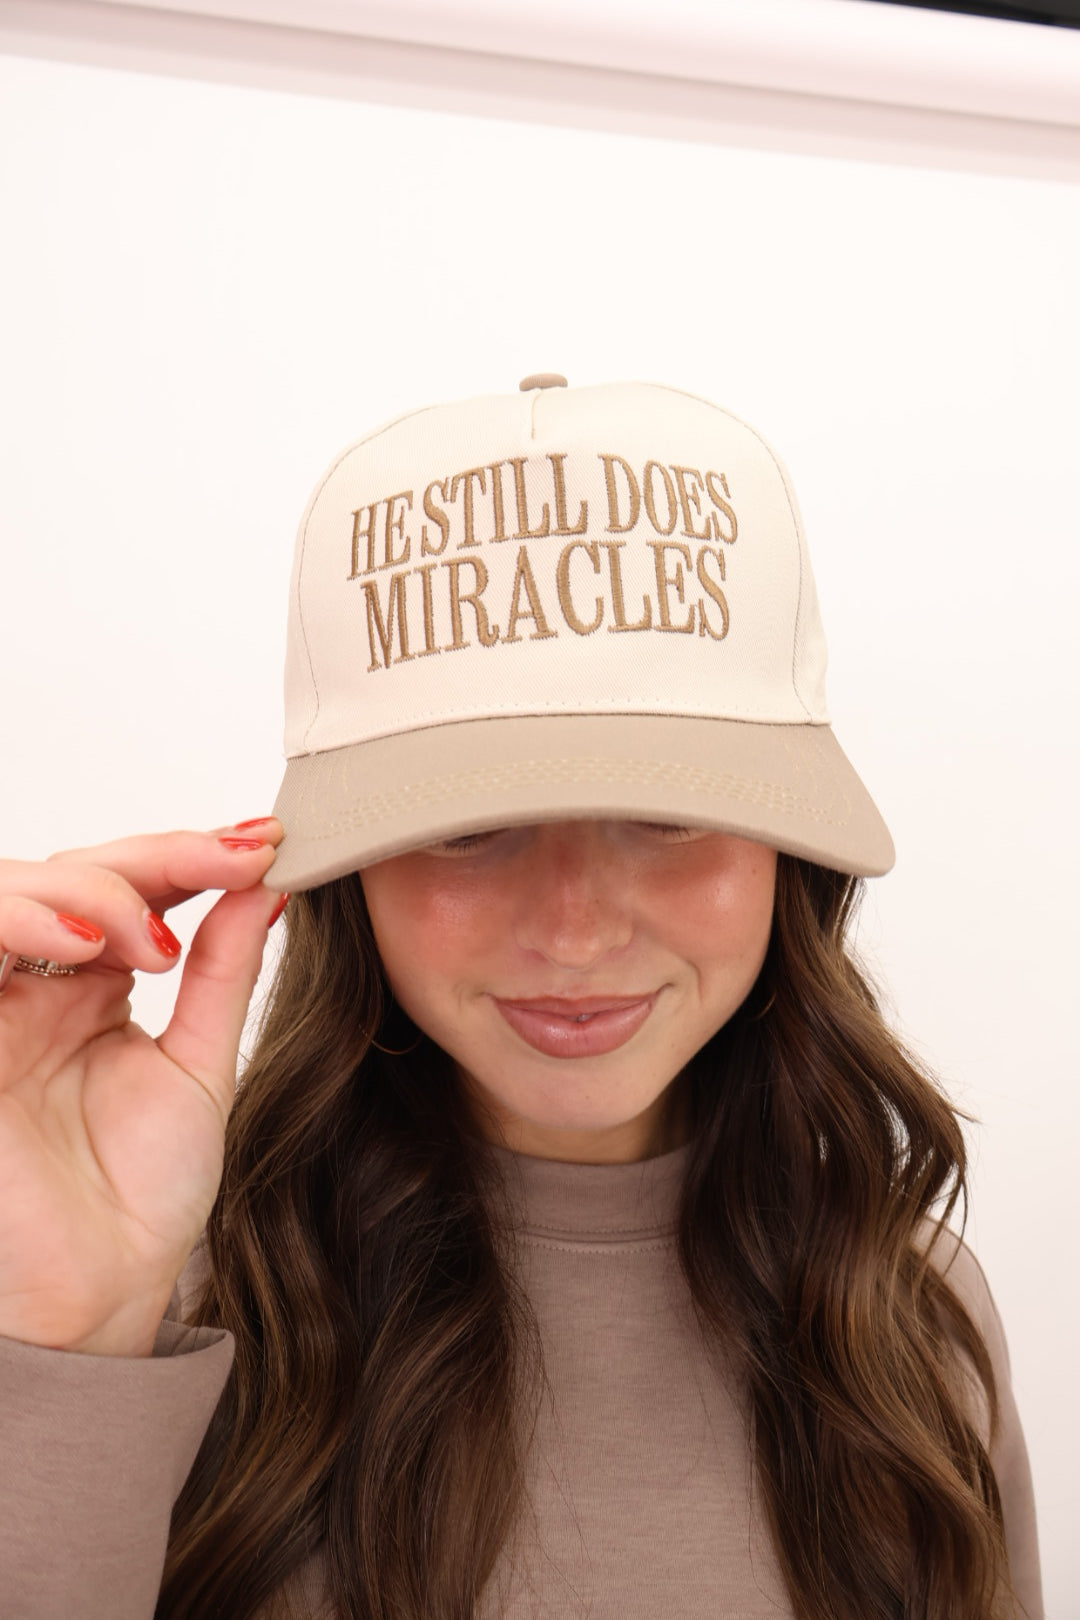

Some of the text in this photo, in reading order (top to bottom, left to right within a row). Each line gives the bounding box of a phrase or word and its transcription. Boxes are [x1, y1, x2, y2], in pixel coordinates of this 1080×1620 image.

[347, 453, 739, 581] HE STILL DOES
[361, 541, 730, 673] MIRACLES
